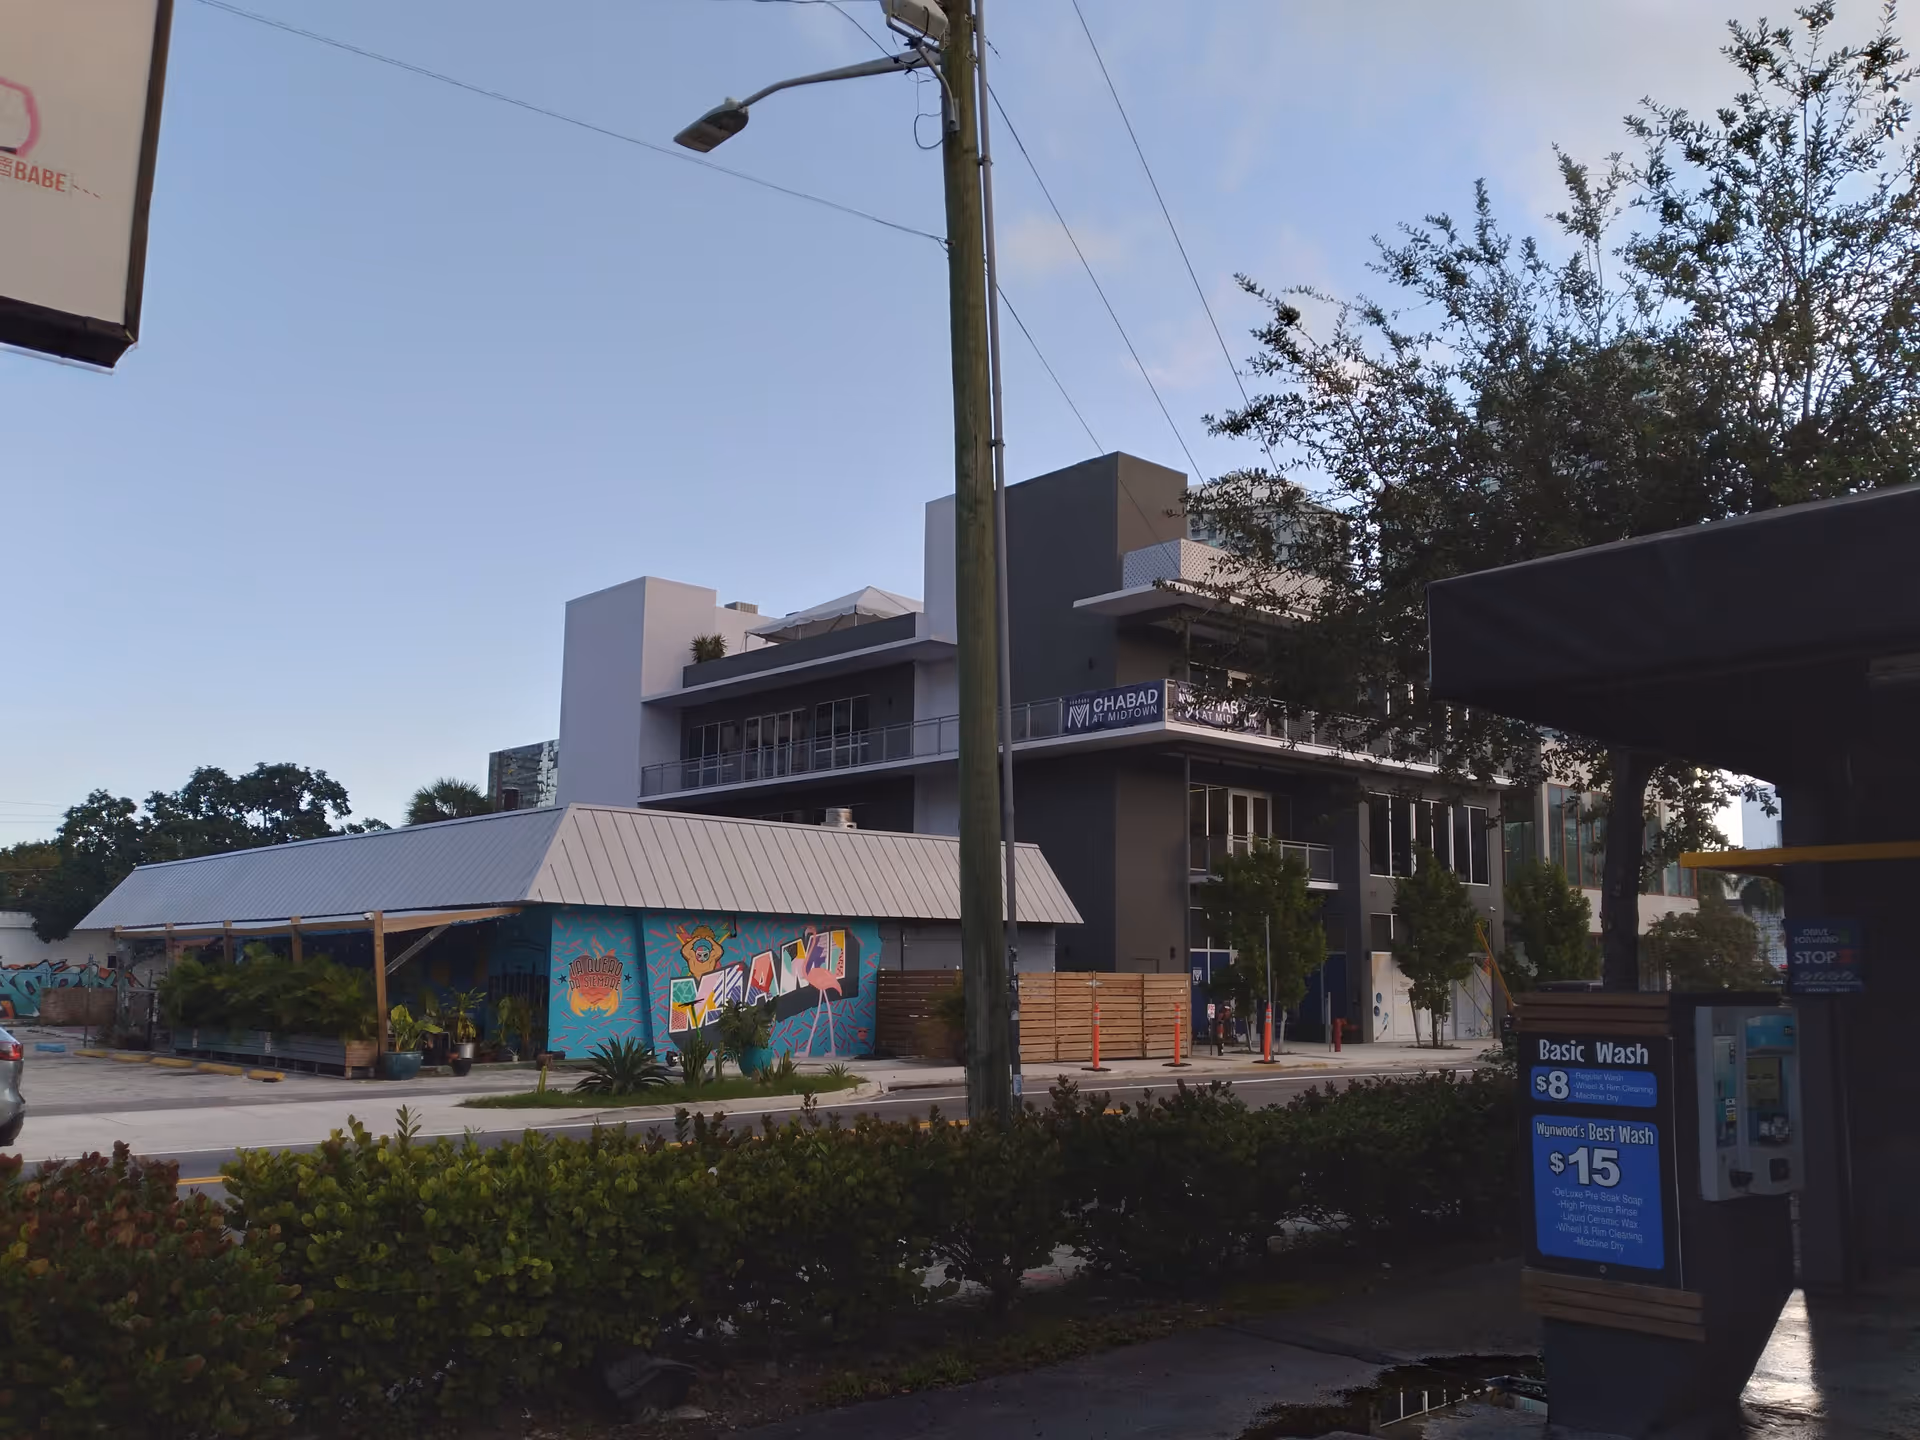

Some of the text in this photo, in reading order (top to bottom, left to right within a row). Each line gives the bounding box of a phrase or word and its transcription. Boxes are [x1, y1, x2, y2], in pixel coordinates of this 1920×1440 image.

[14, 160, 67, 192] BABE
[1093, 689, 1158, 713] CHABAD
[1092, 705, 1158, 724] AT MIDTOWN
[1202, 711, 1213, 721] AT
[1794, 951, 1838, 964] STOP
[668, 929, 847, 1033] MIAMI
[1539, 1039, 1649, 1065] Basic Wash
[1536, 1070, 1570, 1100] $8
[1607, 1093, 1620, 1103] Dry
[1588, 1122, 1616, 1142] Best
[1618, 1125, 1654, 1145] Wash
[1549, 1146, 1621, 1187] $15
[1585, 1190, 1599, 1200] Pre
[1600, 1191, 1621, 1203] Soak
[1622, 1194, 1643, 1207] Soap
[1580, 1202, 1614, 1214] Pressure
[1616, 1205, 1638, 1217] Rinse
[1587, 1214, 1620, 1226] Ceramic
[1622, 1218, 1639, 1229] Wax
[1583, 1226, 1589, 1235] &
[1591, 1226, 1607, 1237] Rim
[1608, 1228, 1643, 1243] Cleaning
[1610, 1241, 1625, 1252] Dry
